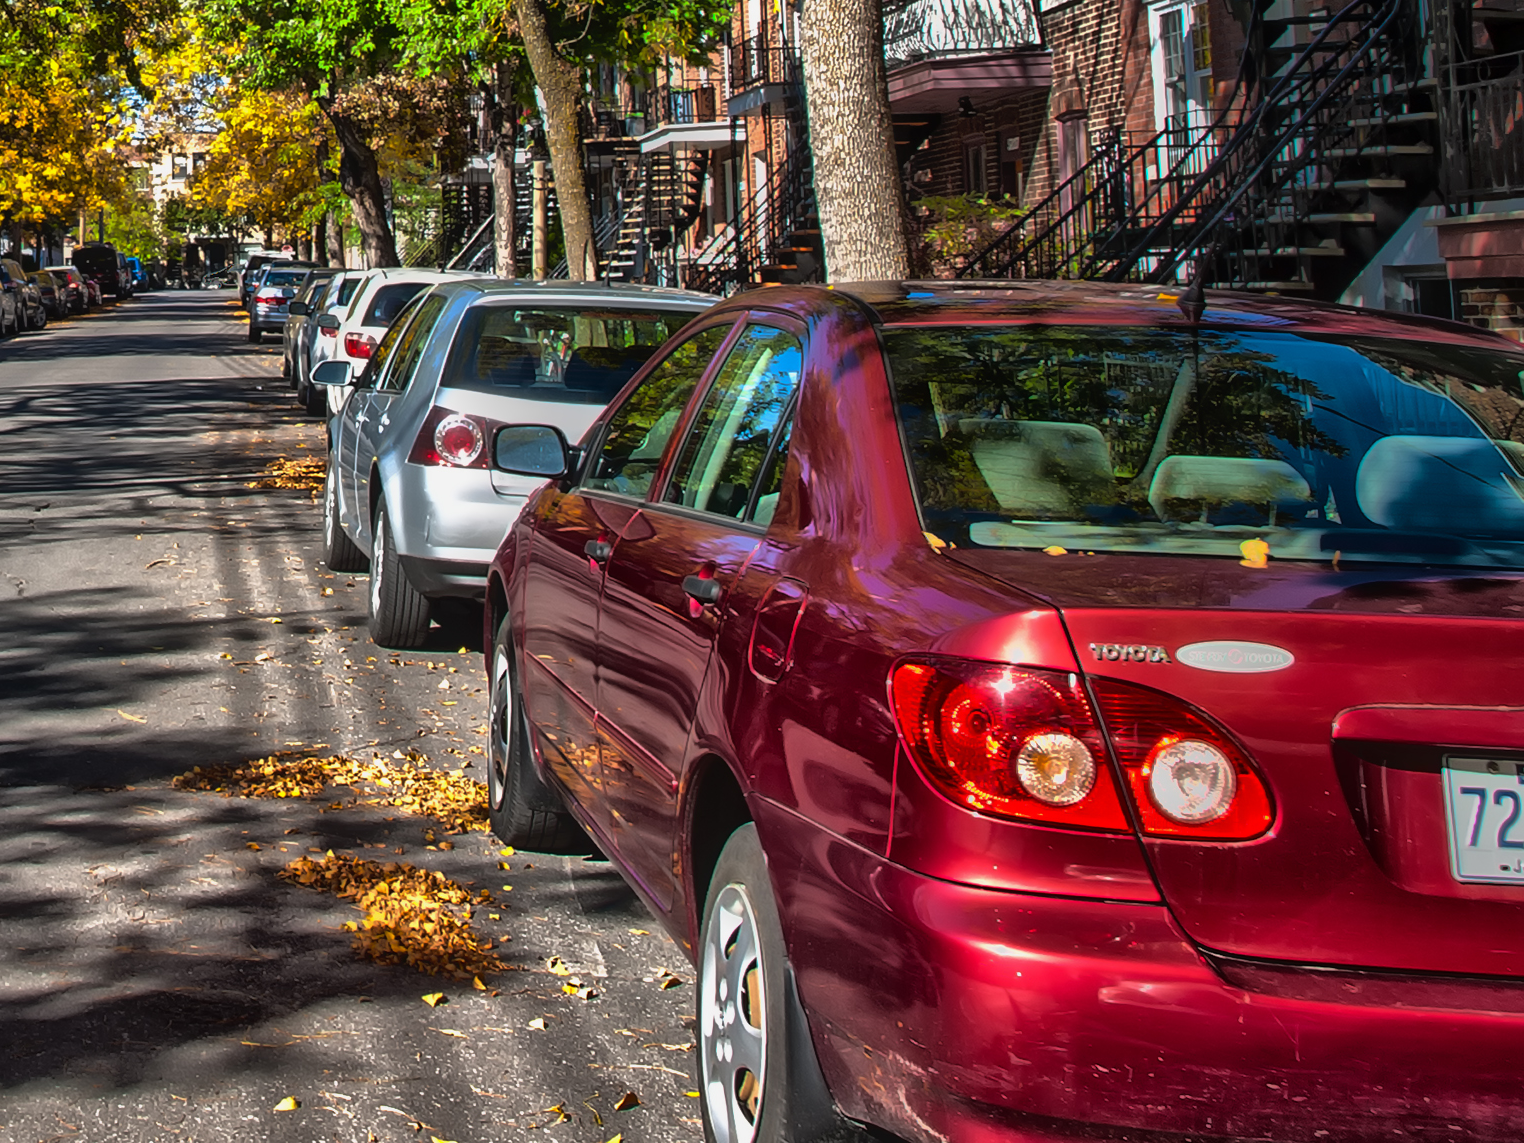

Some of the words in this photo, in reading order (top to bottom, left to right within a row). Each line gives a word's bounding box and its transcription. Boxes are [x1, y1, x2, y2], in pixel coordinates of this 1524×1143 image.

[1090, 643, 1172, 663] TOYOTA
[1243, 652, 1284, 664] TOYOTA
[1459, 786, 1524, 848] 72
